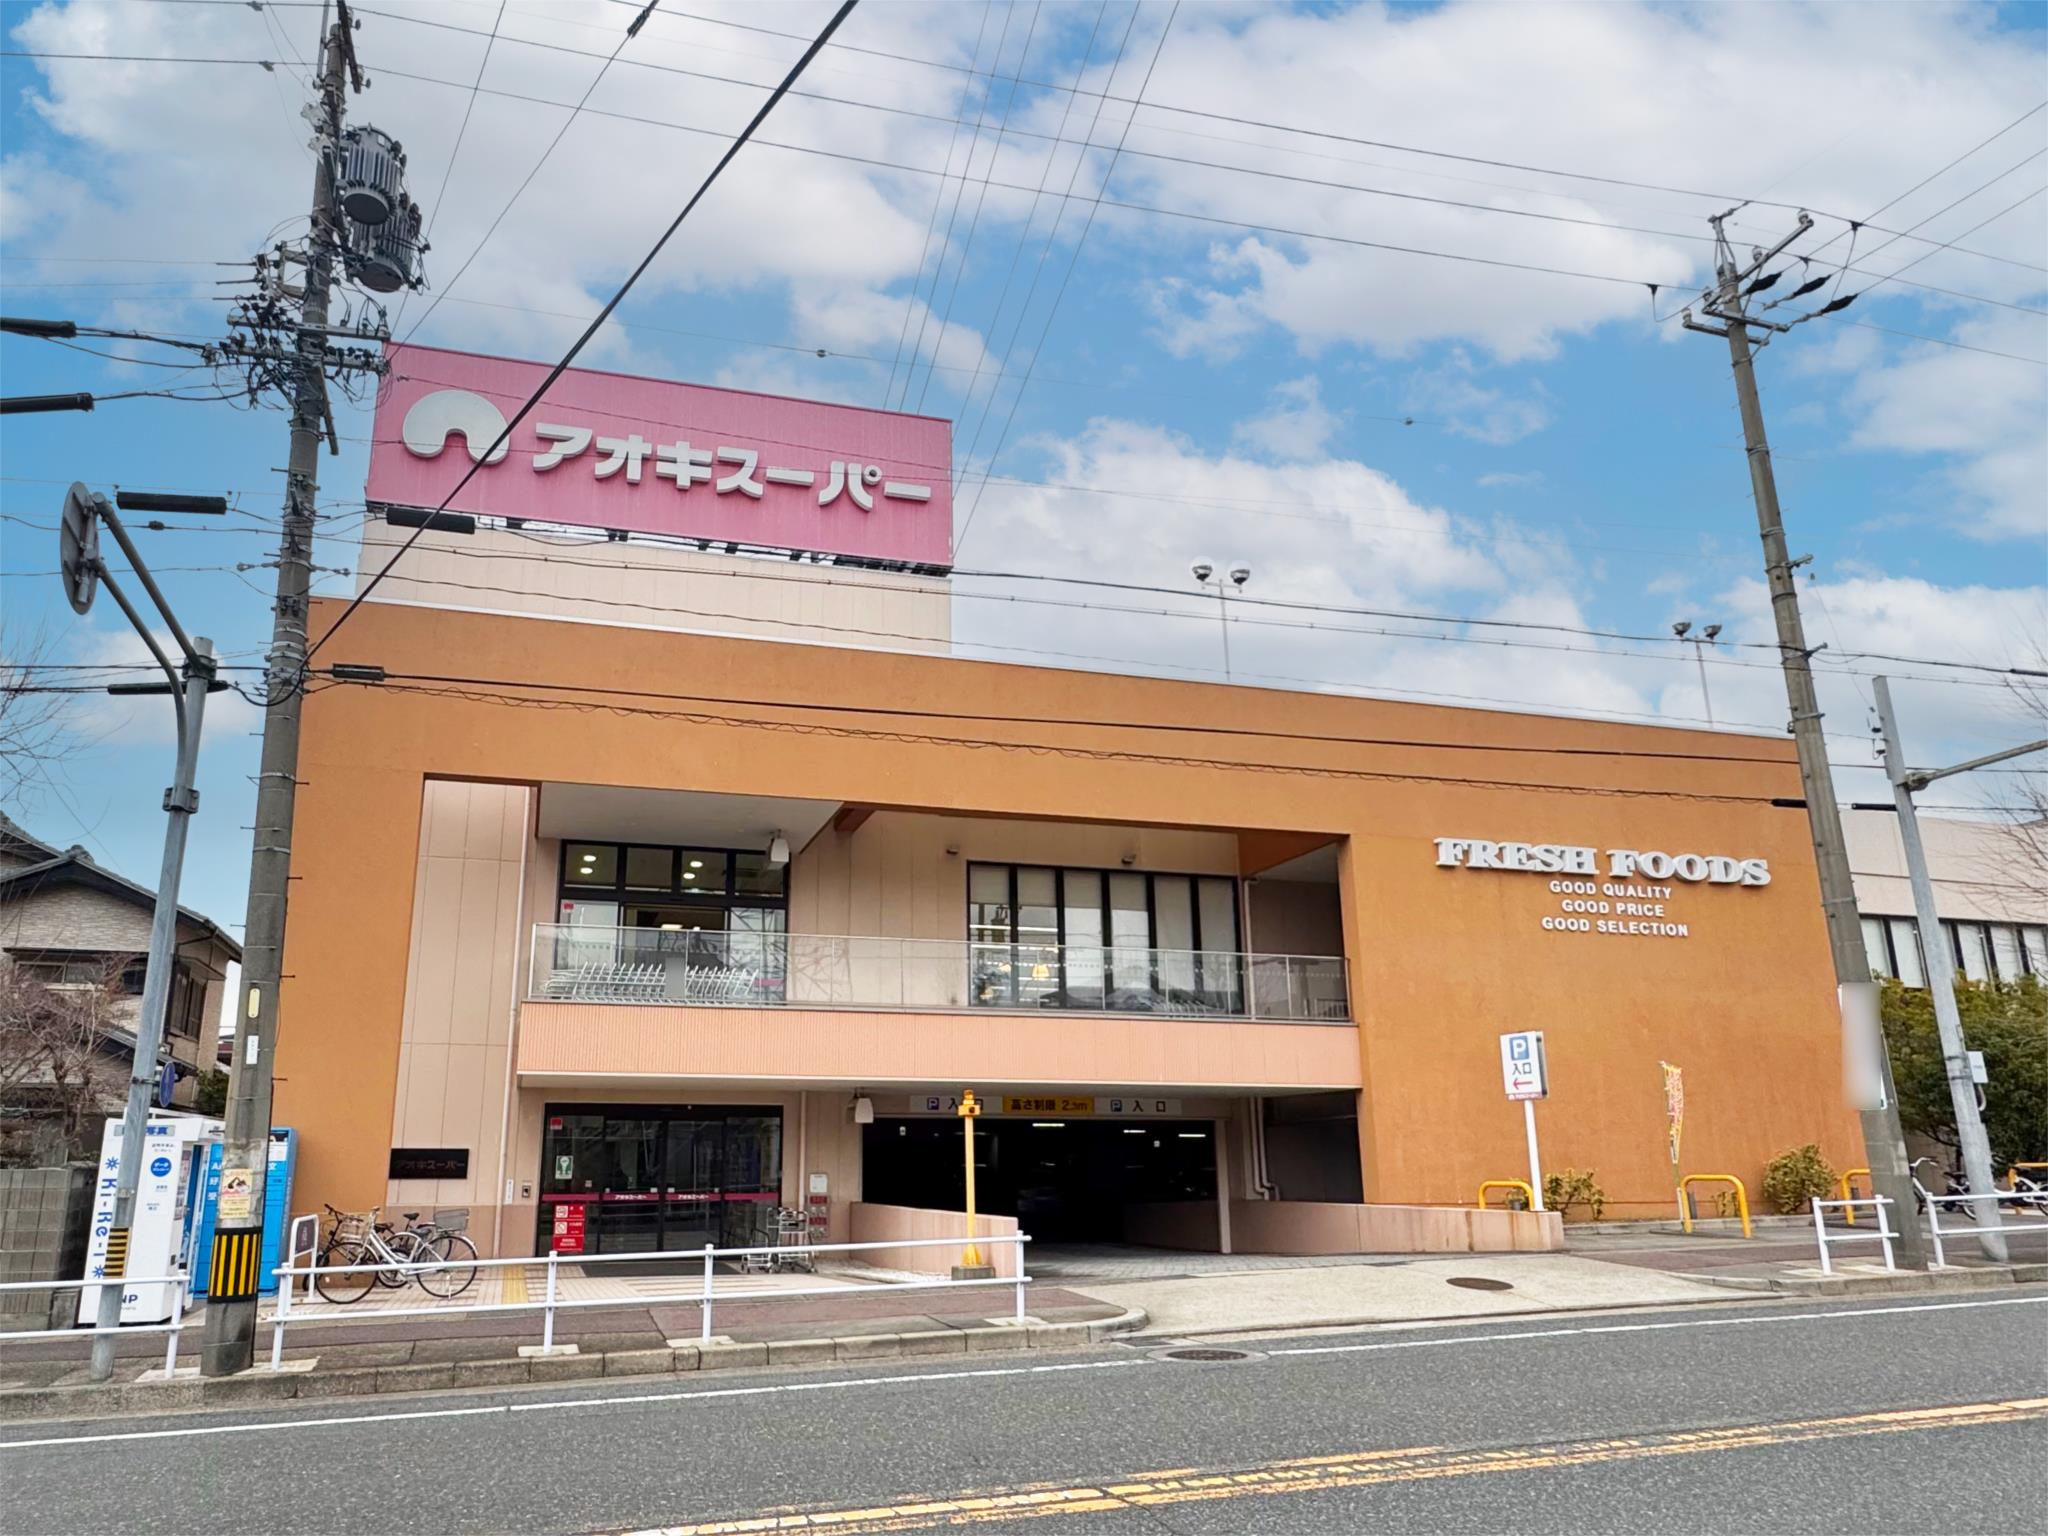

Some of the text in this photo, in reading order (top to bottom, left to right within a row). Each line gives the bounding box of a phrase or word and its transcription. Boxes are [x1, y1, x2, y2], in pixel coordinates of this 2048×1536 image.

[532, 422, 932, 512] アオキスーパー
[1434, 837, 1771, 887] FRESH FOODS
[1549, 880, 1672, 899] GOOD QUALITY
[1561, 900, 1665, 917] GOOD PRICE
[1541, 917, 1689, 937] GOOD SELECTION
[1512, 1062, 1532, 1075] 入口
